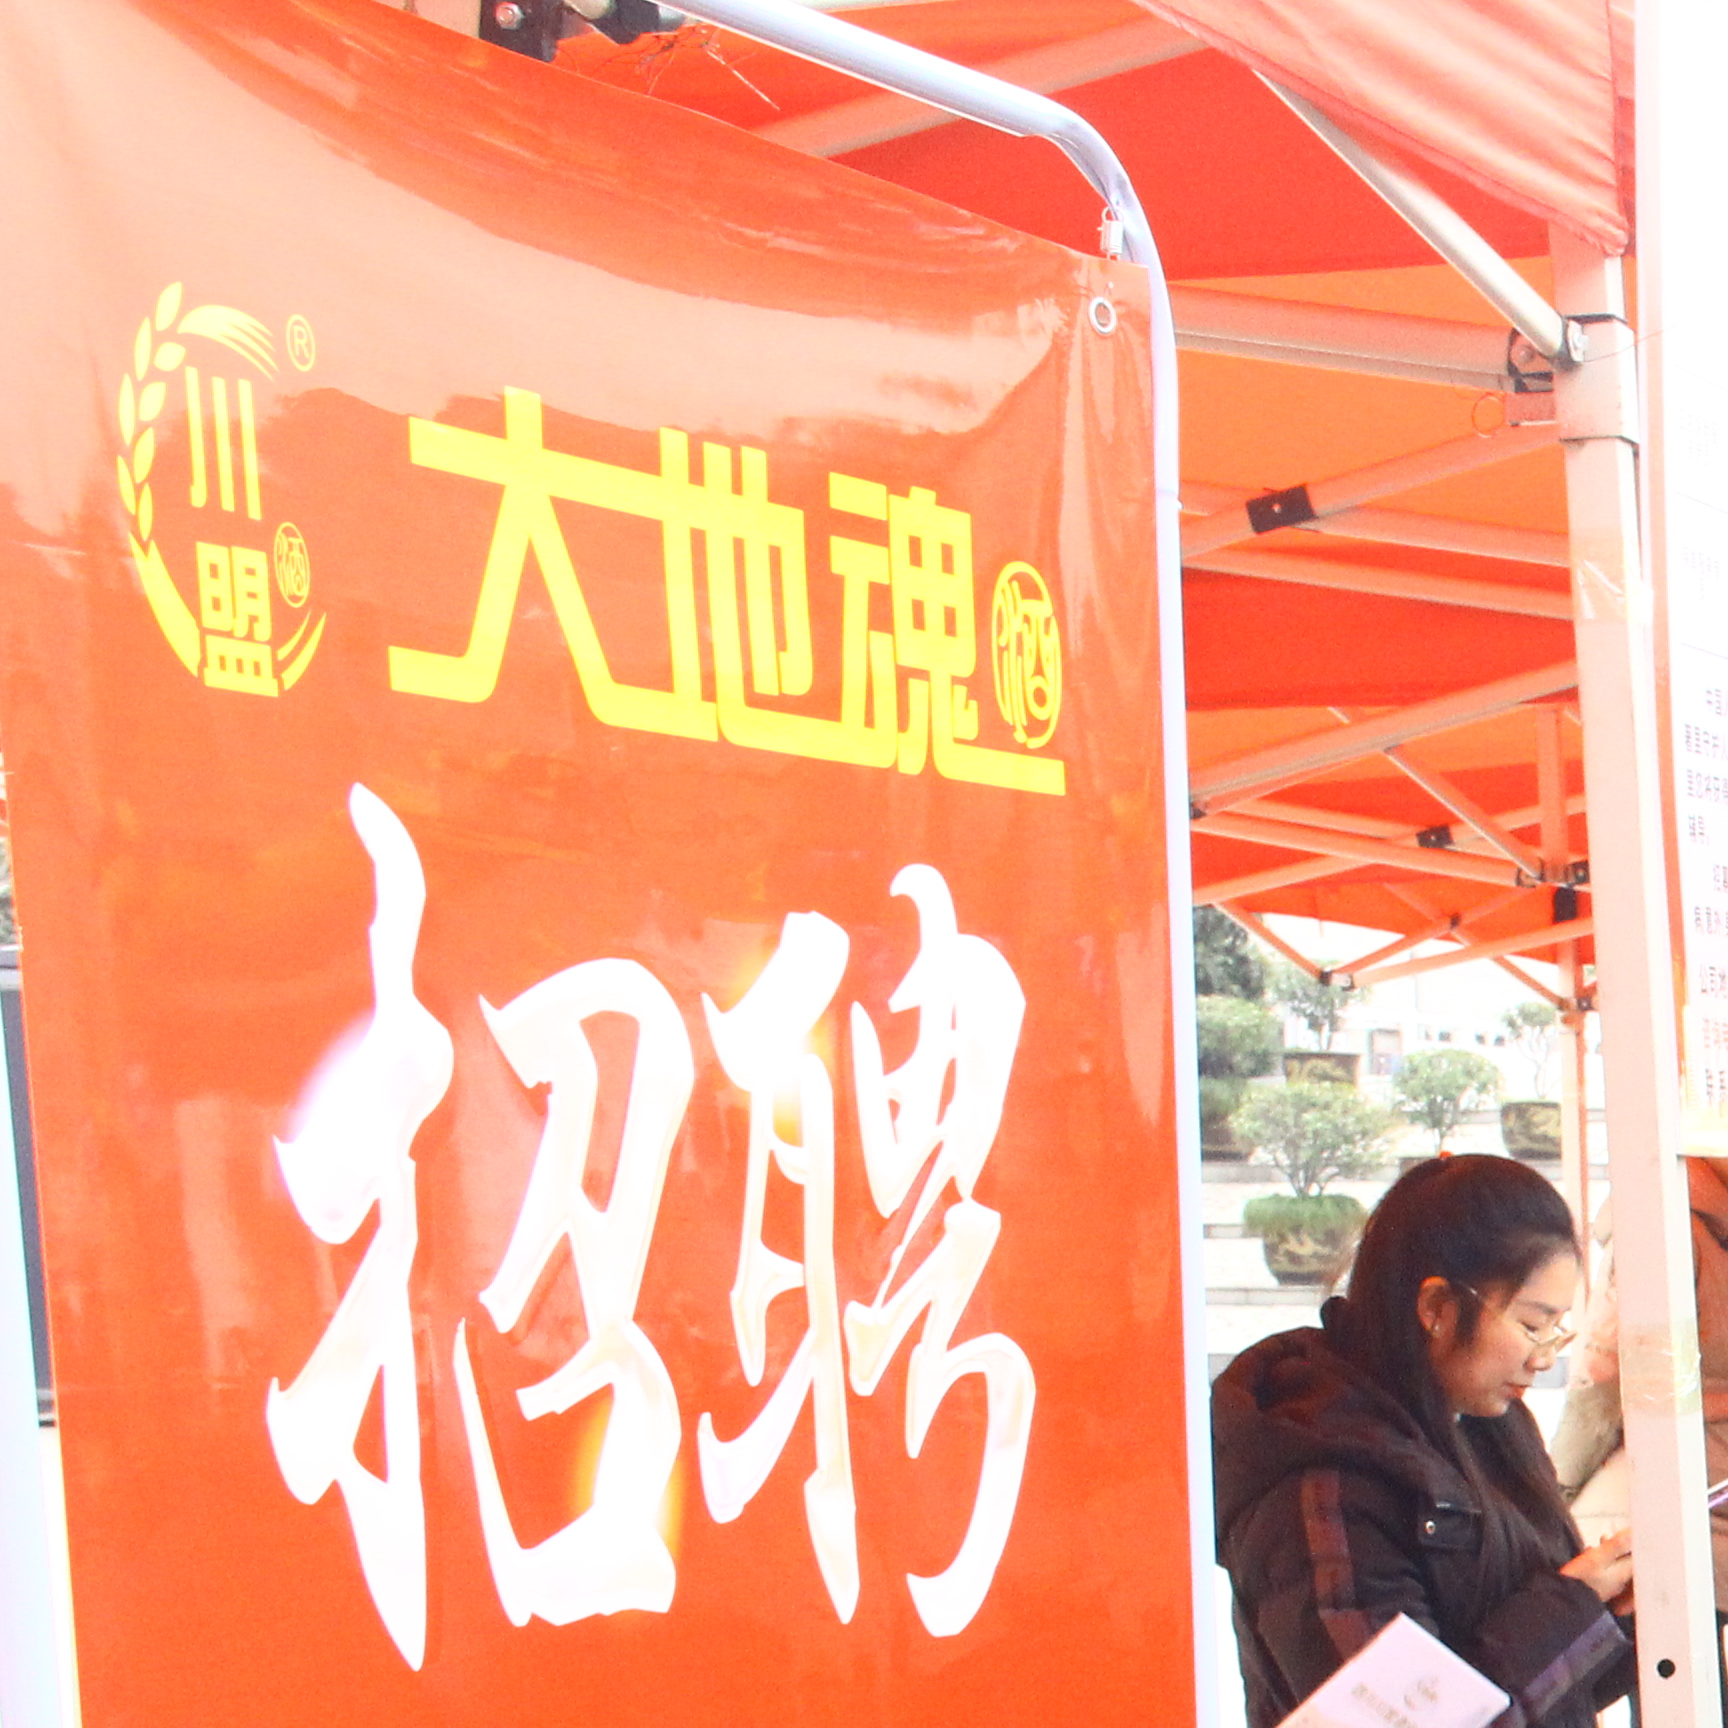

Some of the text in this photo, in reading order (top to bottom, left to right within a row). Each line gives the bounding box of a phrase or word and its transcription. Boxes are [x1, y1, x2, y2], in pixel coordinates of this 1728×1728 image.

[184, 366, 279, 698] 川盟
[388, 385, 1067, 797] 大地魂
[266, 781, 1037, 1672] 招聘
